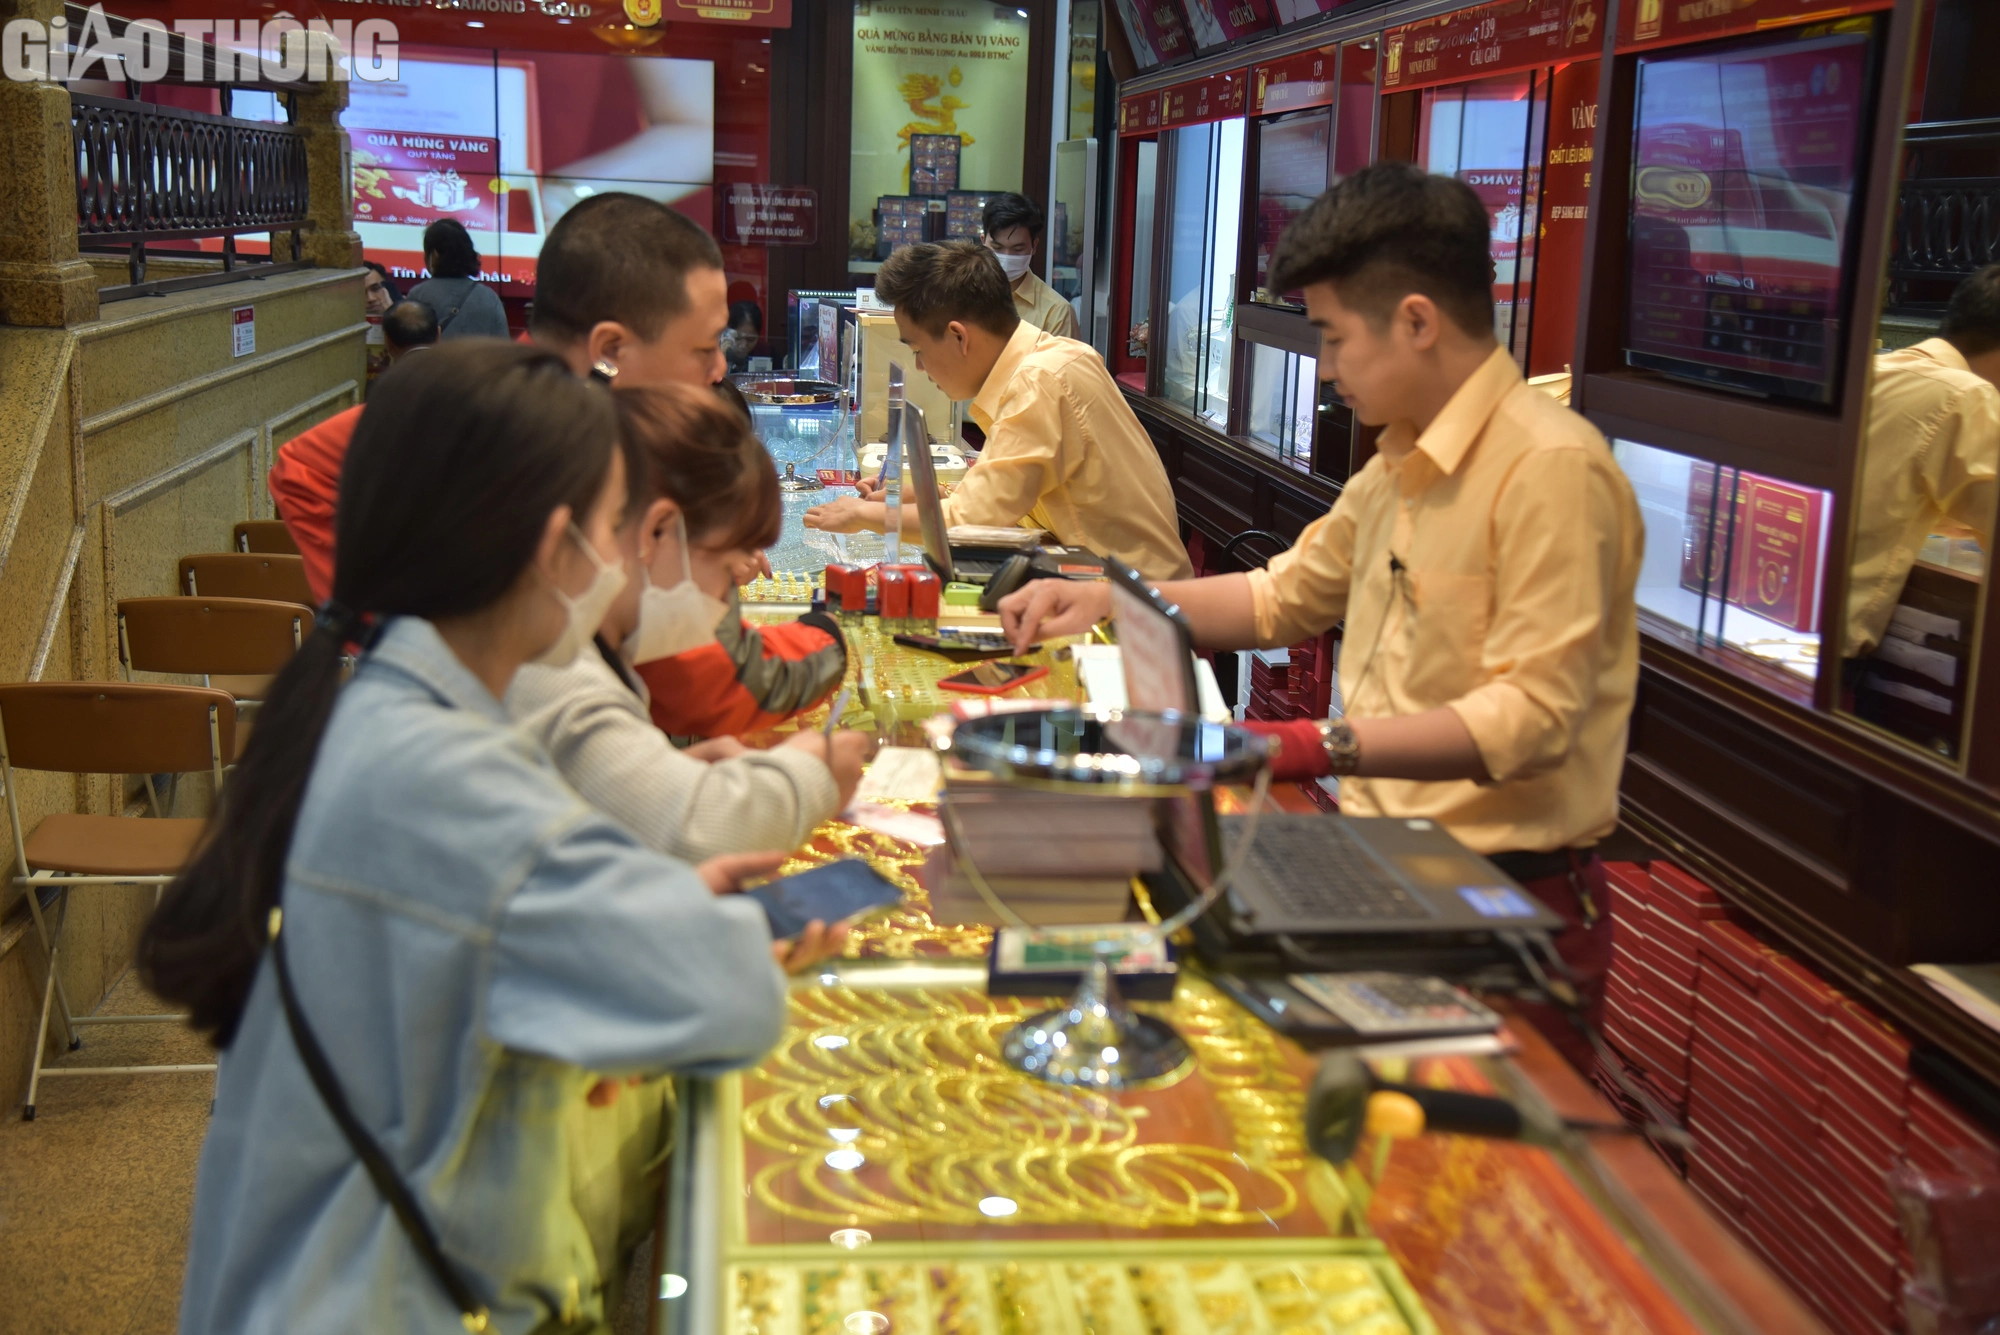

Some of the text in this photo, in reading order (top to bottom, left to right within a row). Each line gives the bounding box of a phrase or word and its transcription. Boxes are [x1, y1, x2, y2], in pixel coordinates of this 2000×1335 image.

[540, 0, 590, 17] GOLD
[915, 8, 940, 16] MINH
[857, 28, 880, 40] QUÀ
[883, 28, 915, 42] MỪNG
[990, 34, 1020, 47] VÀNG
[1480, 18, 1496, 39] 139
[1314, 60, 1323, 77] 139
[1571, 101, 1598, 129] VÀNG
[367, 133, 489, 153] QUÀ MỪNG VÀNG
[1550, 143, 1565, 164] CHẤT
[391, 266, 417, 279] Tín
